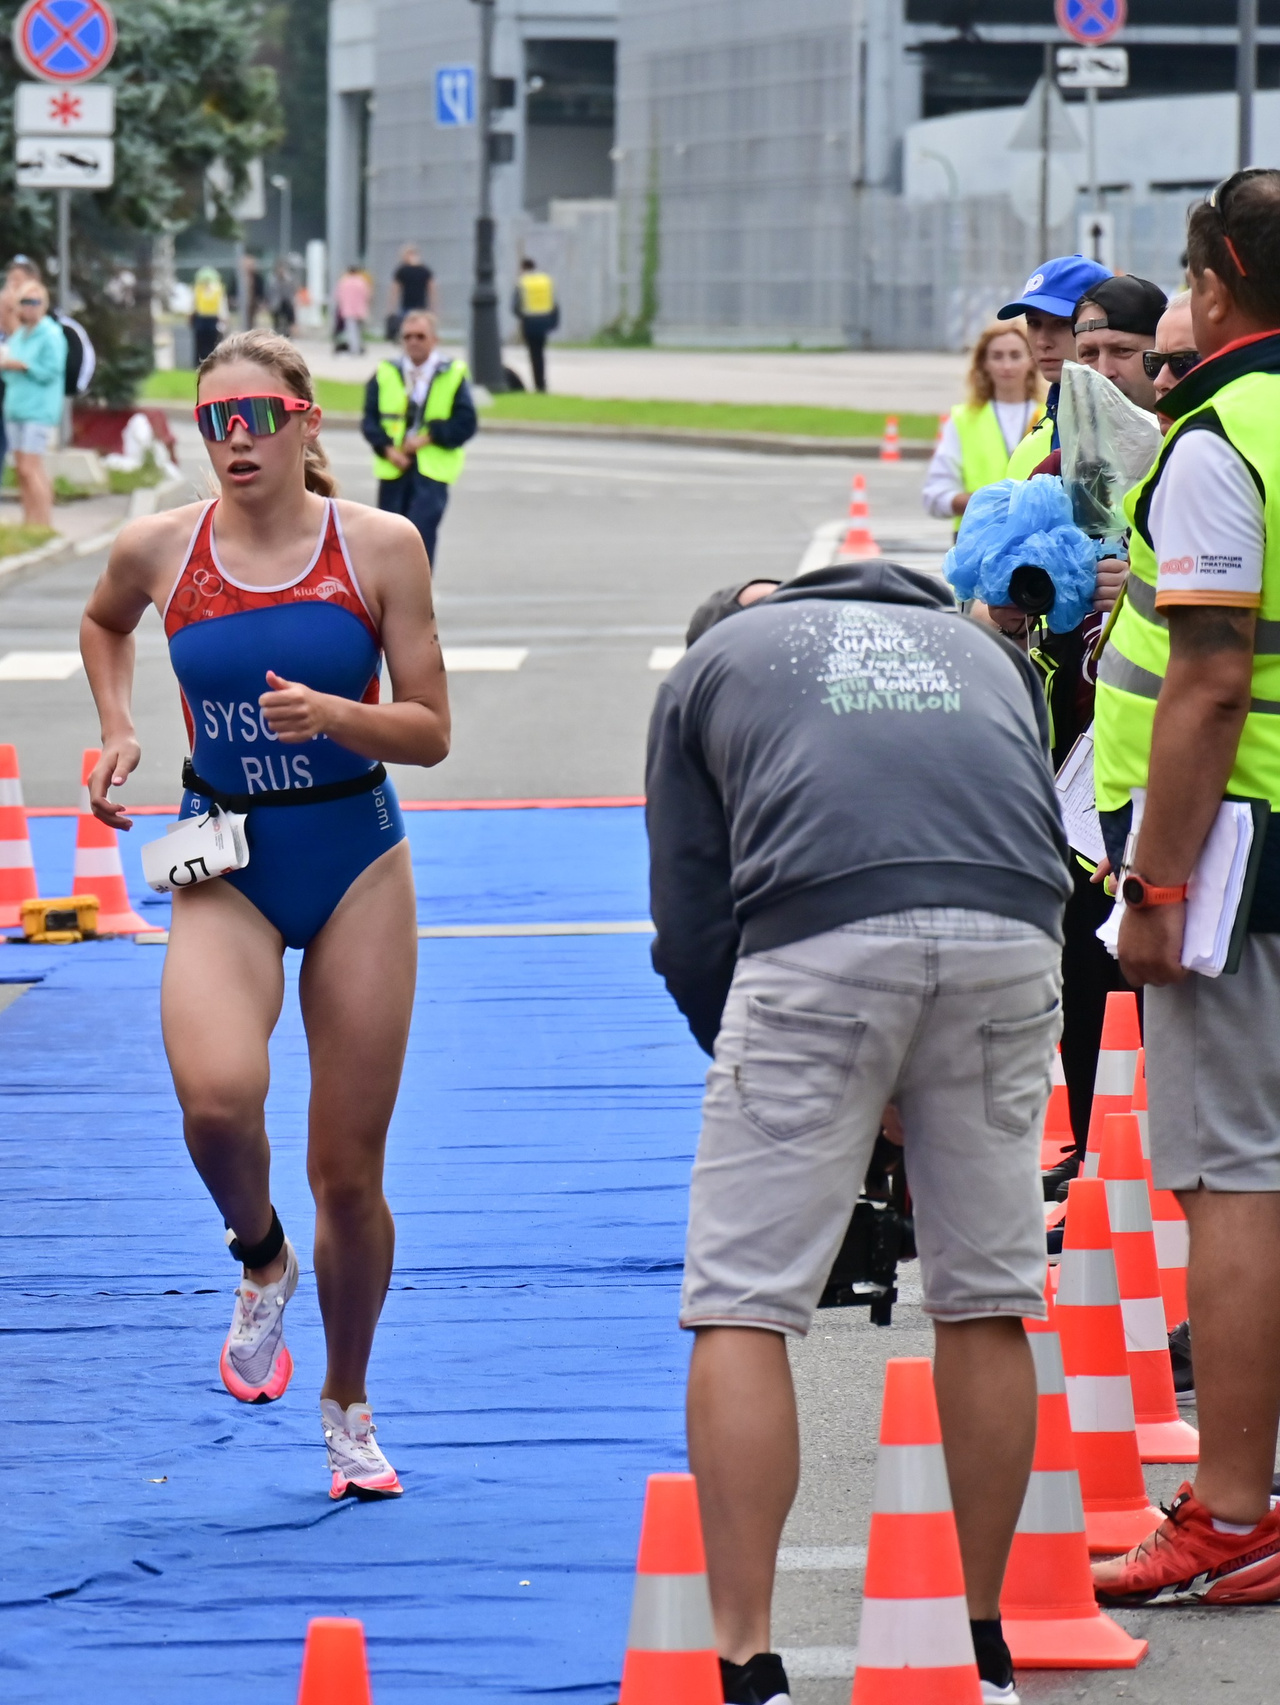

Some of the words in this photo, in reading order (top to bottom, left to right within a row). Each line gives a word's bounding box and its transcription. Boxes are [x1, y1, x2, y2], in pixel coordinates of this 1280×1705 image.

[293, 582, 339, 598] kiwami
[833, 636, 919, 655] CHANCE
[874, 676, 954, 693] IRONSTAR
[821, 691, 961, 716] TRIATHLON
[241, 754, 314, 795] RUS
[169, 857, 210, 887] 5
[1220, 1540, 1280, 1575] SALOMO
